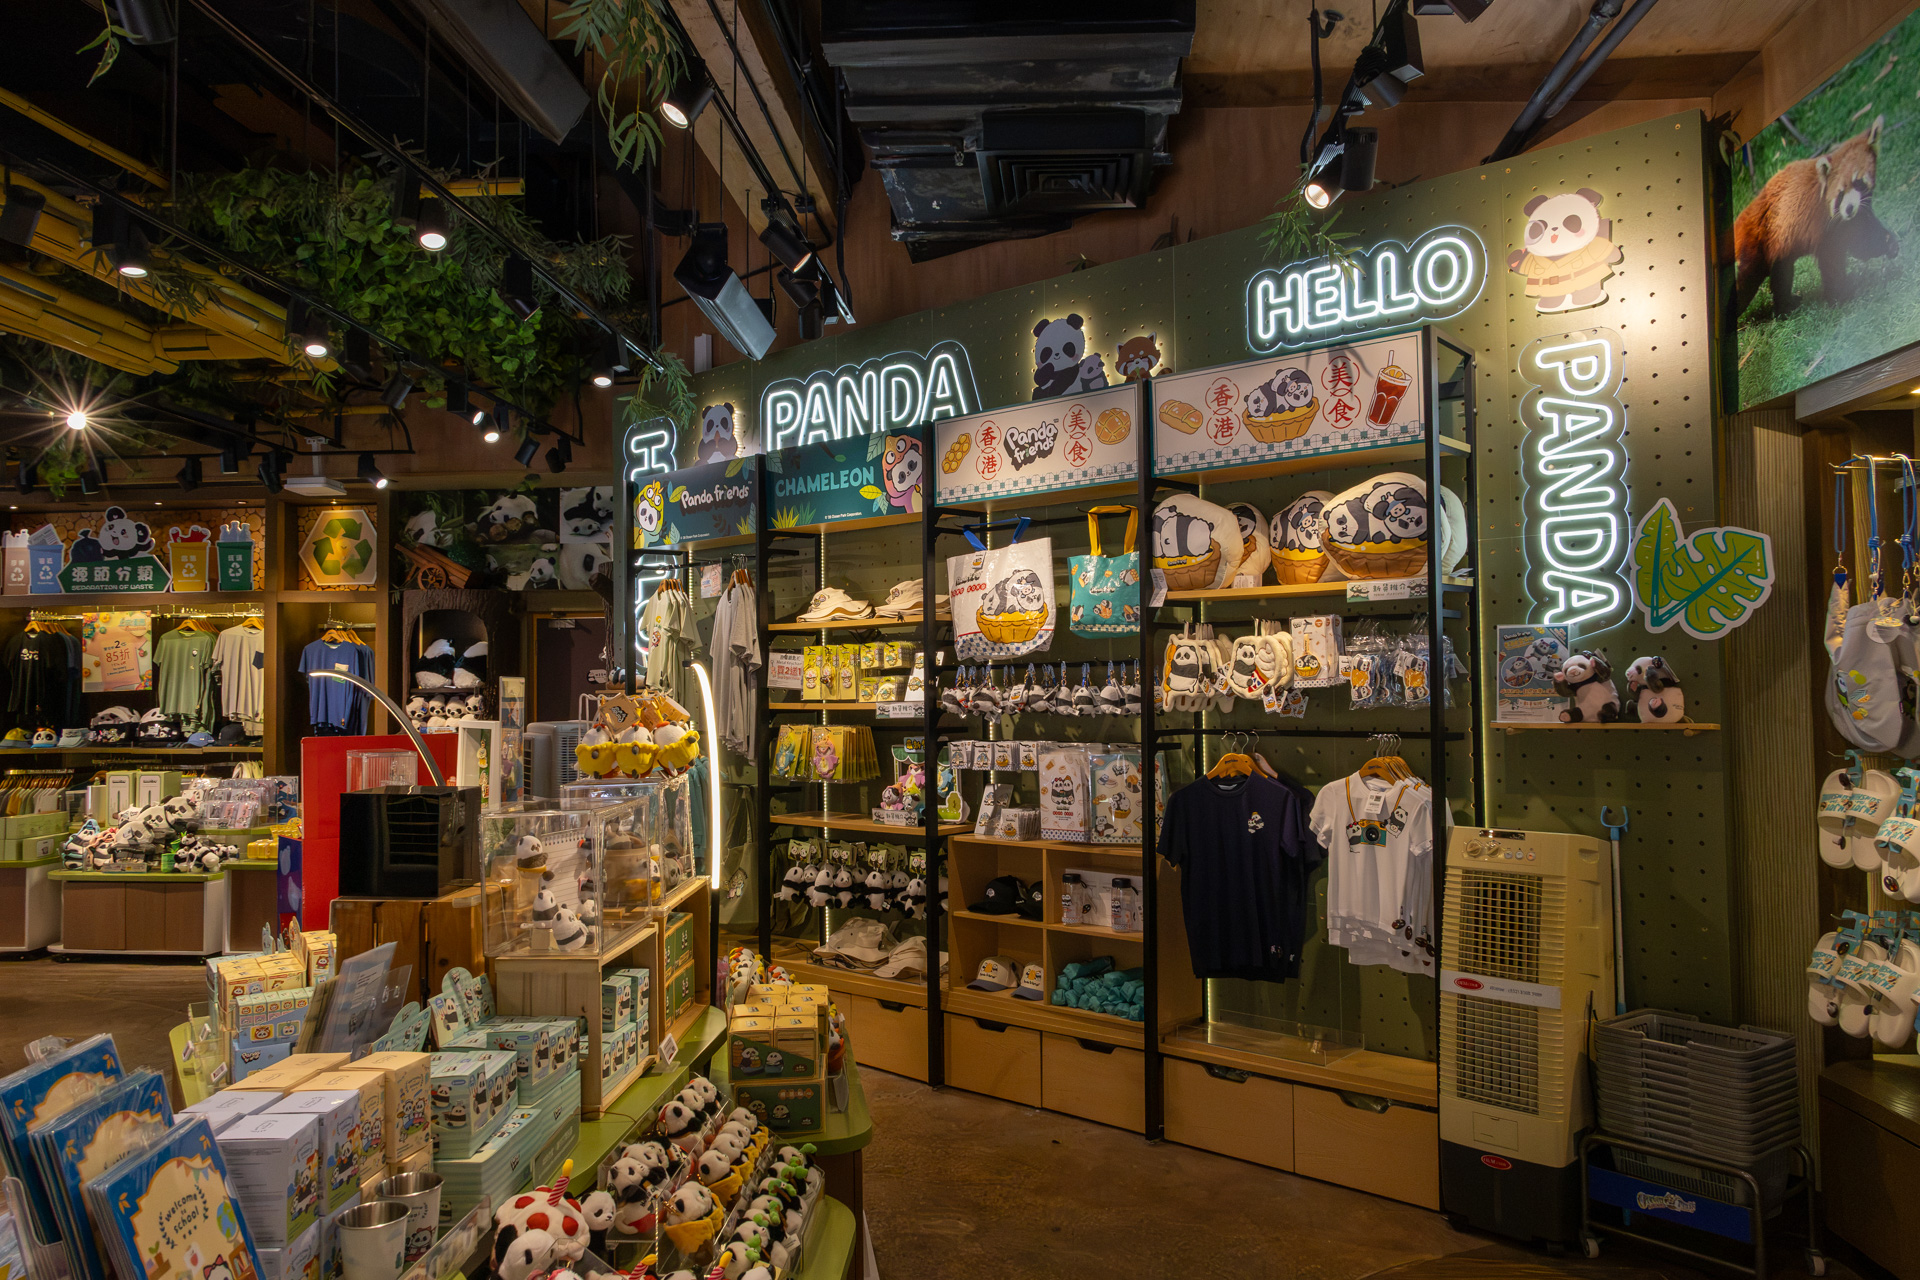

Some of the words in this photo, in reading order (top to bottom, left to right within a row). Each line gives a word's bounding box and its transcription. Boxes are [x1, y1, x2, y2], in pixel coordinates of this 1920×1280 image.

[1256, 236, 1475, 340] HELLO
[766, 353, 968, 452] PANDA
[1328, 361, 1356, 424] 美食
[1210, 383, 1234, 440] 香港
[979, 426, 998, 475] 香港
[1005, 420, 1059, 450] Panda
[1013, 436, 1055, 464] friends
[1068, 409, 1089, 463] 美食
[680, 489, 714, 509] Panda
[713, 484, 750, 502] friends
[775, 465, 875, 498] CHAMELEON
[1535, 337, 1620, 625] PANDA
[72, 565, 154, 582] 源頭分類
[105, 648, 130, 663] 85折
[164, 1192, 198, 1223] welcome
[173, 1204, 200, 1235] school
